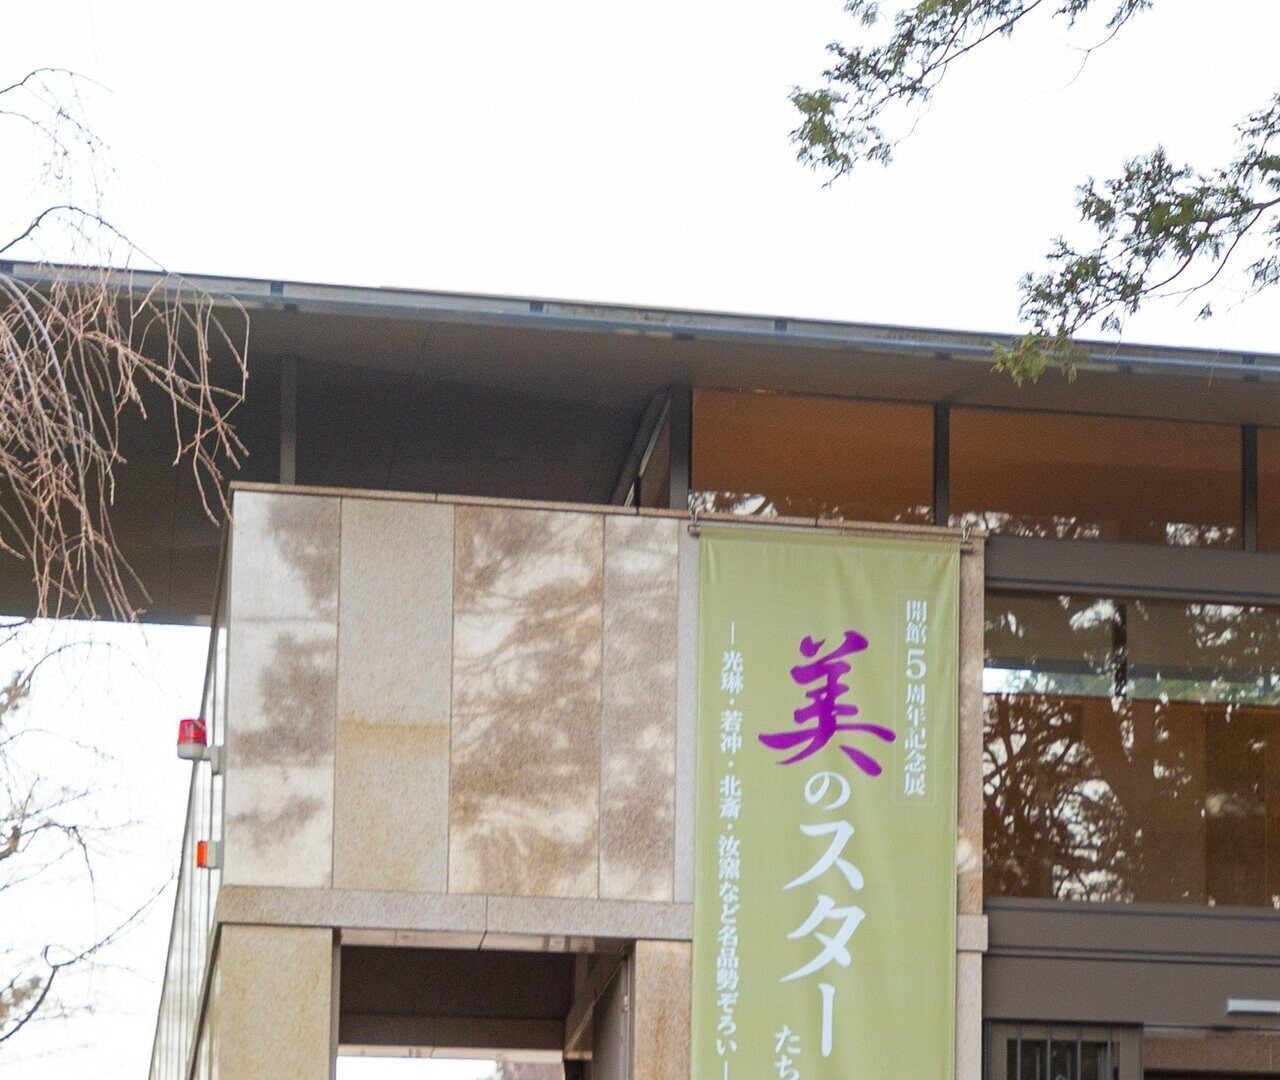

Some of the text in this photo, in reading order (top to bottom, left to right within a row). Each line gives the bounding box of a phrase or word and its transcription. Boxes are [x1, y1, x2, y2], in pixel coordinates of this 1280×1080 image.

[904, 600, 928, 797] 開館5周年記念展
